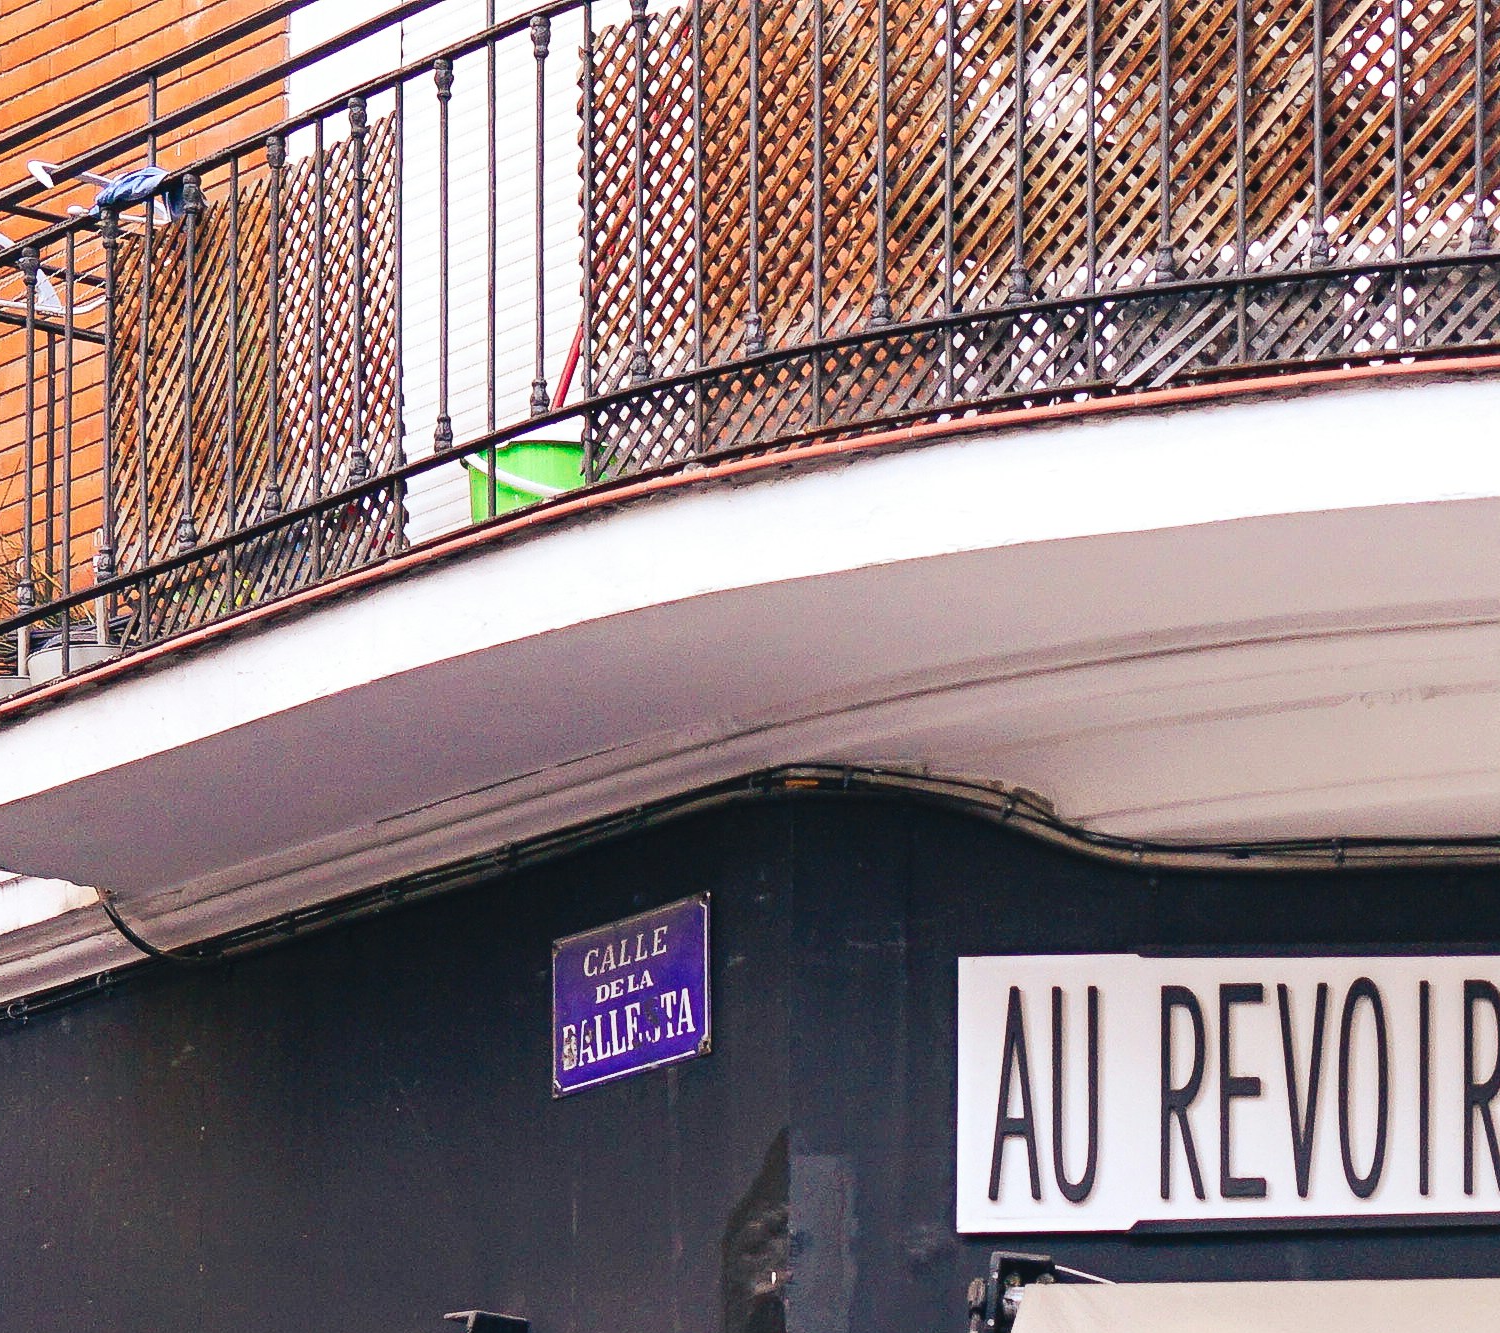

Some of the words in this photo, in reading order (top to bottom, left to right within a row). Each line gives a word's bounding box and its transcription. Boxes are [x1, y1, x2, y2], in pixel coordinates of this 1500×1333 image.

[584, 925, 668, 977] CALLE
[596, 979, 624, 1004] DE
[627, 970, 653, 991] LA
[988, 985, 1099, 1202] AU
